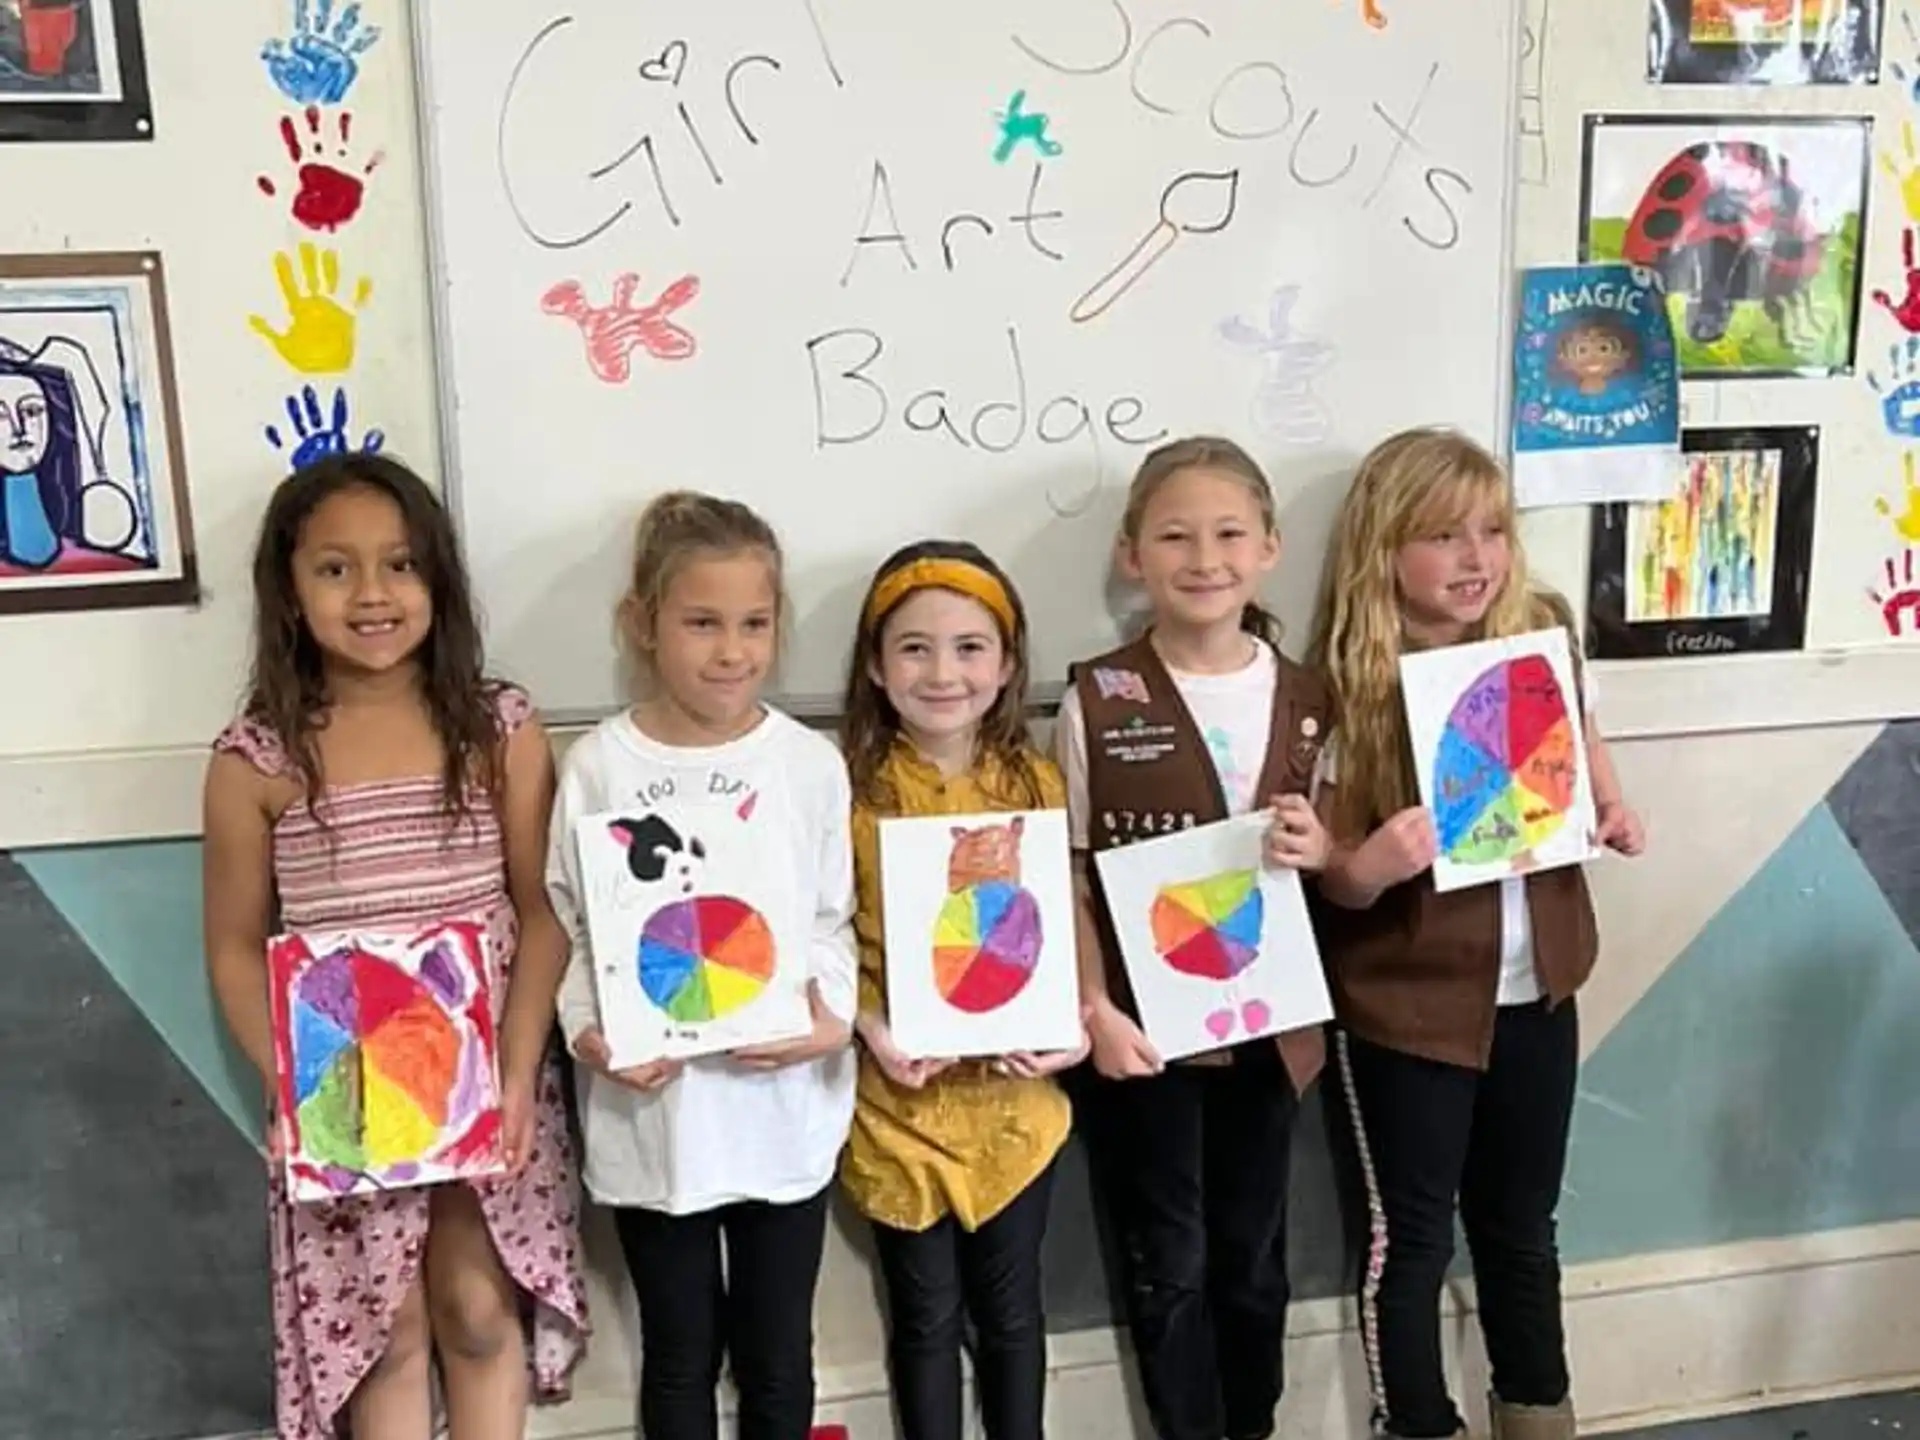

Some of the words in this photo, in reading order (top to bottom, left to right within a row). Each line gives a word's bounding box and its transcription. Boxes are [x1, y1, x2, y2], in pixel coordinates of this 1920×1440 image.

[498, 0, 843, 249] Girl
[840, 160, 1063, 287] Art
[1549, 283, 1644, 315] MAGIC
[806, 328, 1168, 517] Badge
[636, 777, 675, 807] 100
